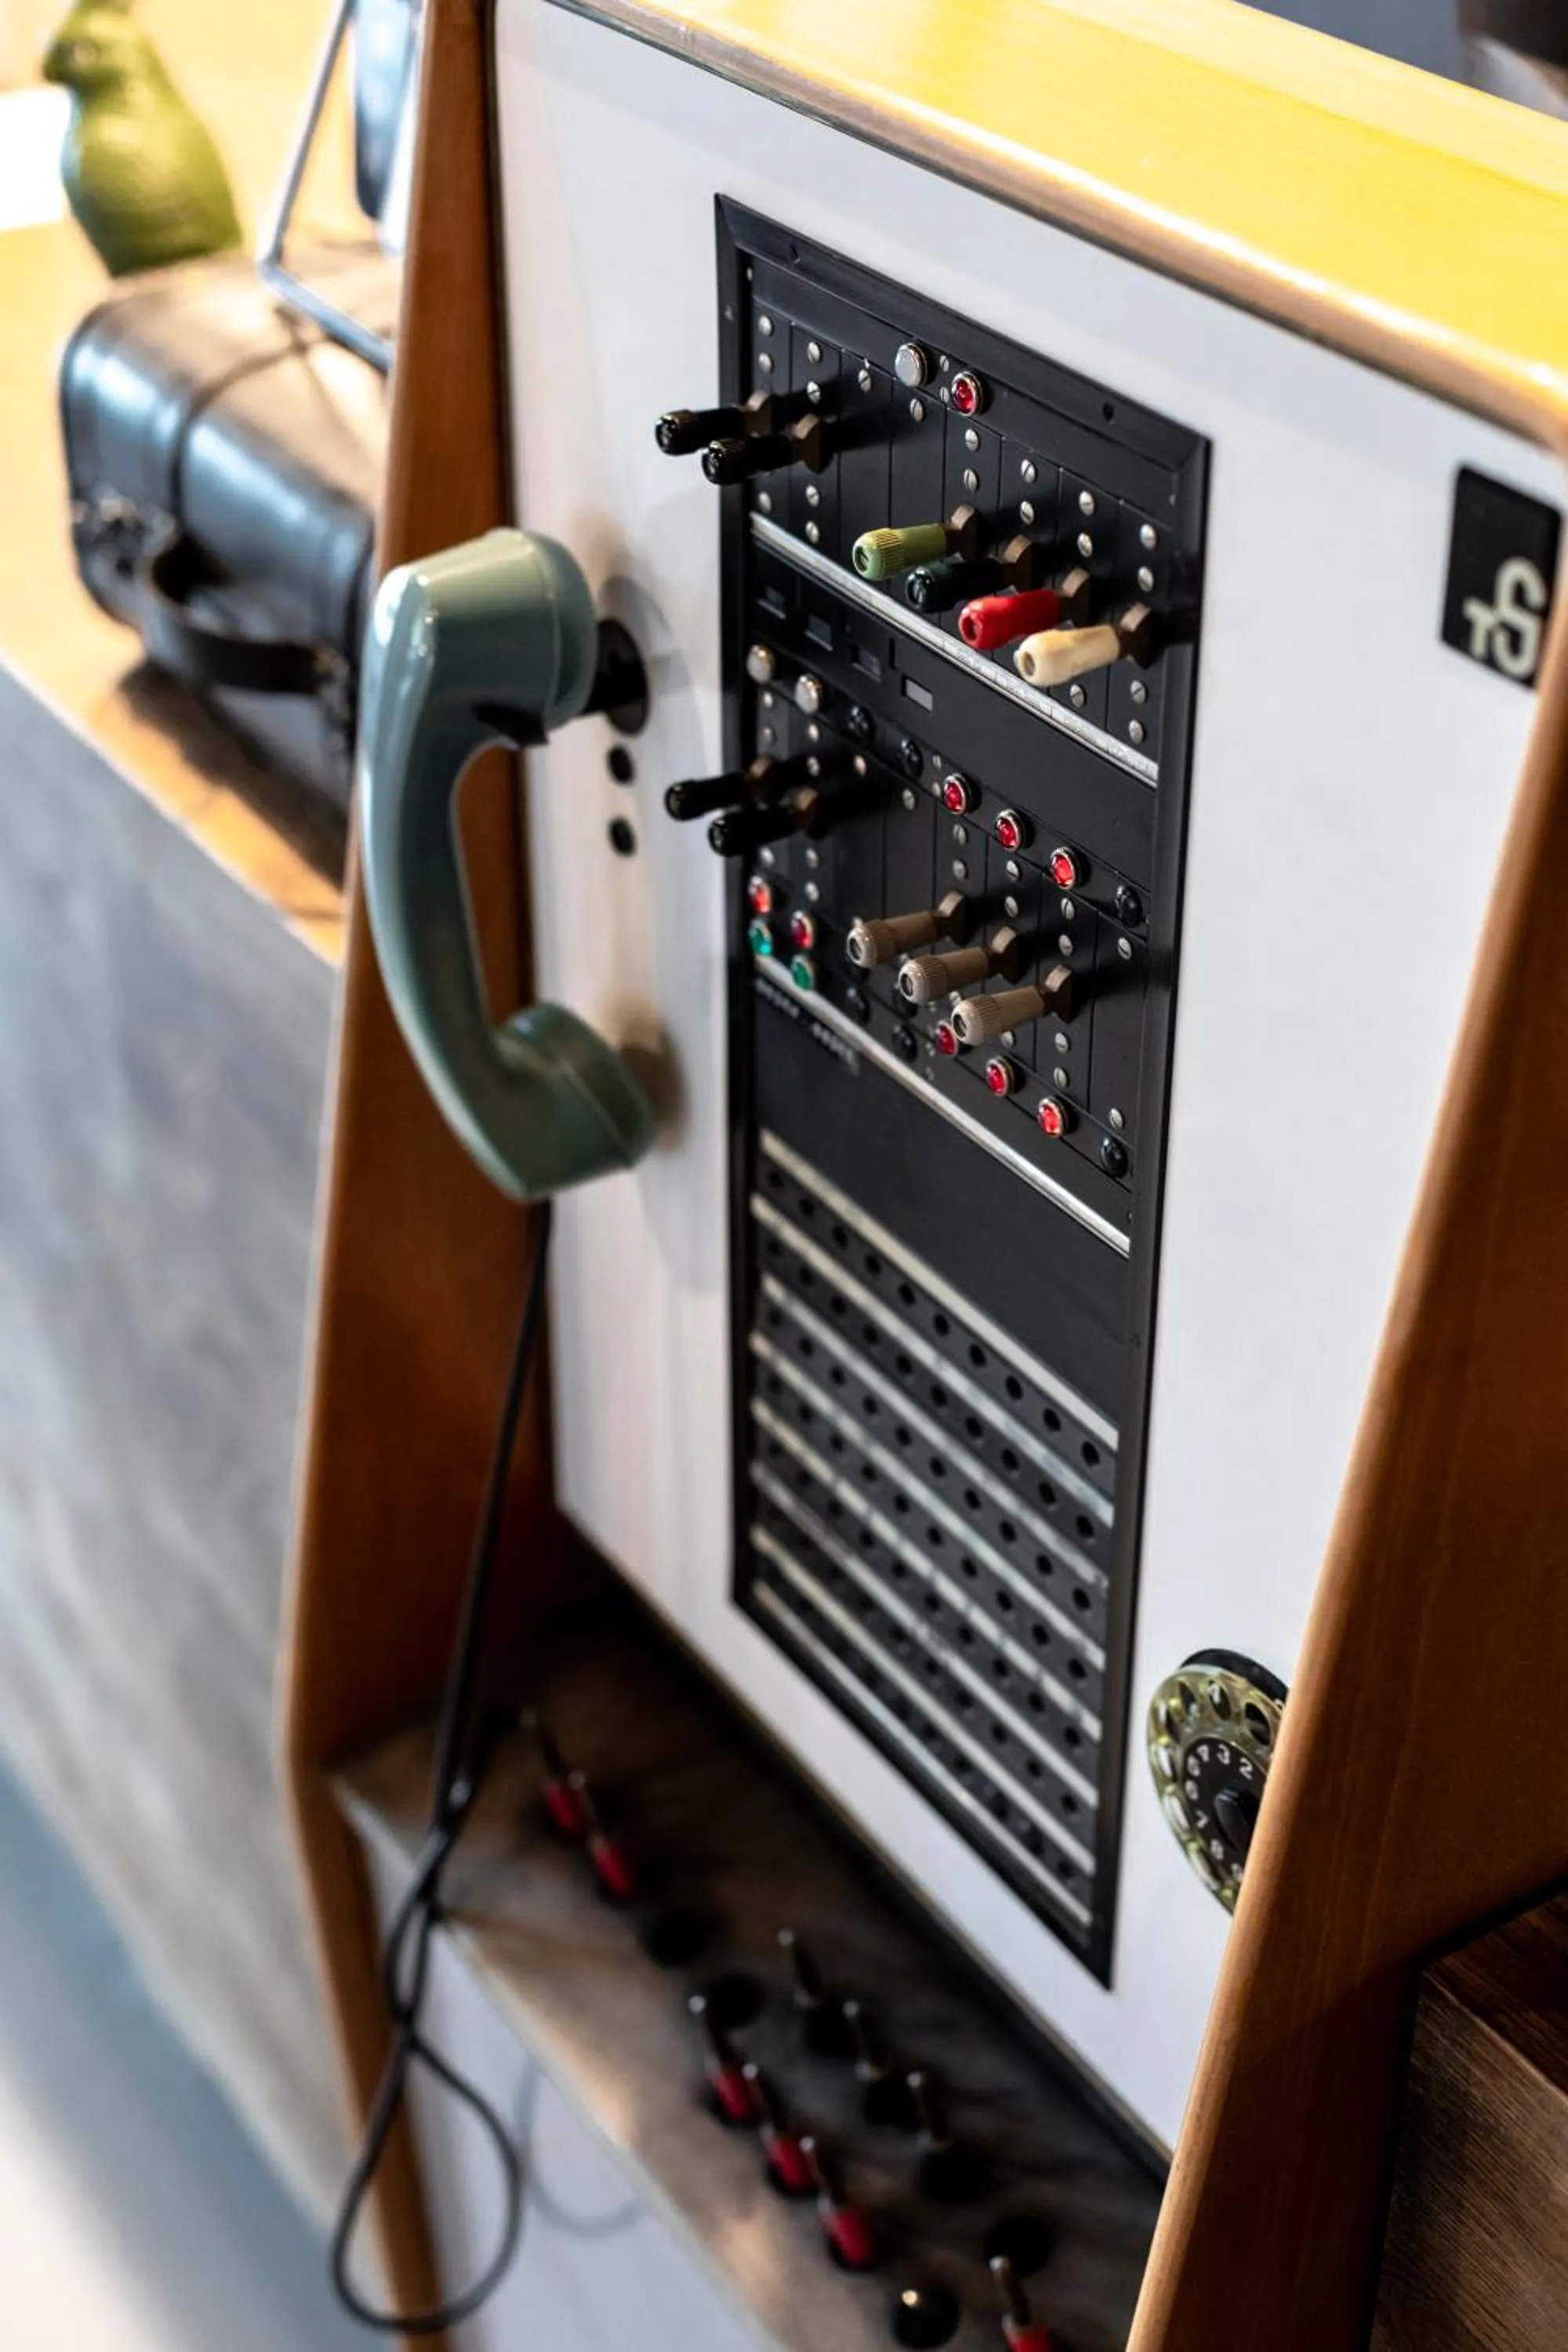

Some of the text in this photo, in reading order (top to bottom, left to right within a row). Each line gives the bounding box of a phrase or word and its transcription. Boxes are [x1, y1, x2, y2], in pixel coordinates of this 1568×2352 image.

[1217, 1744, 1230, 1765] 3
[1239, 1757, 1253, 1780] 2
[1195, 1809, 1208, 1829] 7
